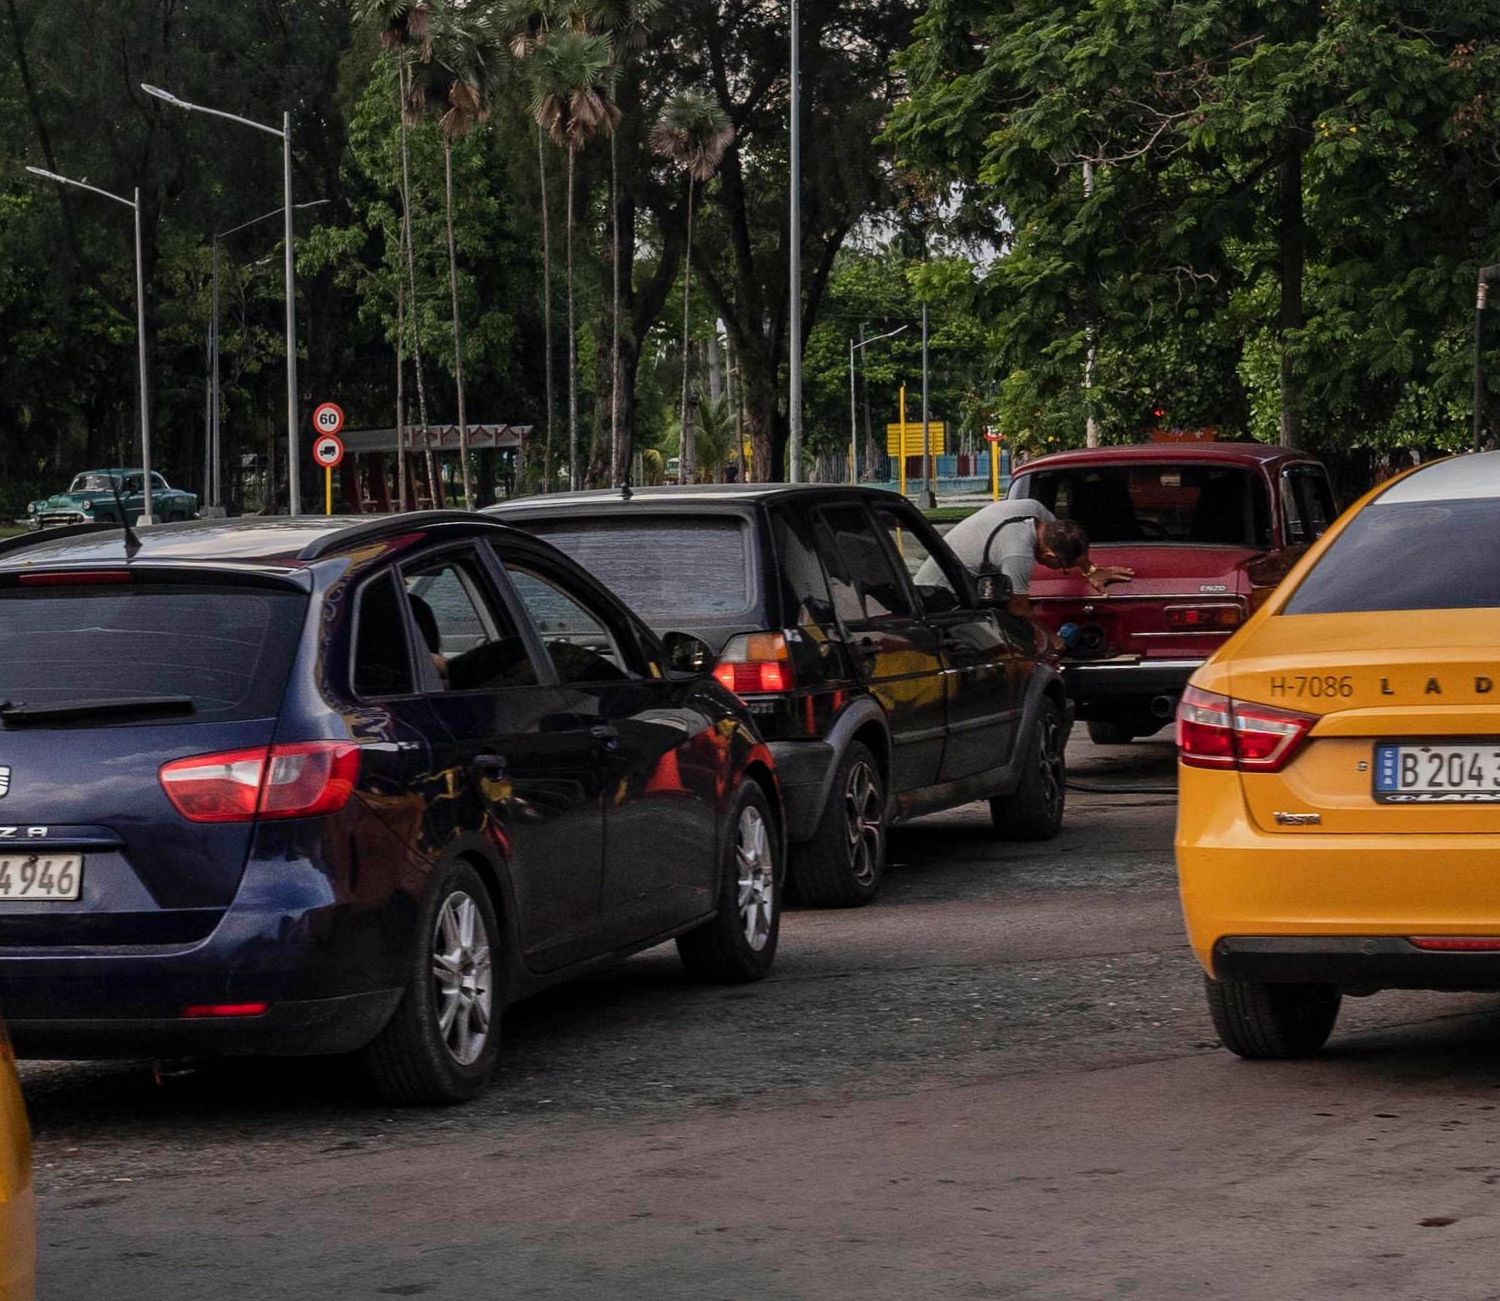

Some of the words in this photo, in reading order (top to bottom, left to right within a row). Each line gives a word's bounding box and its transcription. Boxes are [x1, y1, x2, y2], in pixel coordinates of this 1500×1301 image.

[319, 413, 337, 425] 60
[1270, 675, 1354, 698] H-7086
[1383, 750, 1394, 785] CUBA
[1401, 753, 1419, 788] B
[1427, 752, 1485, 788] 204
[20, 860, 75, 895] 946
